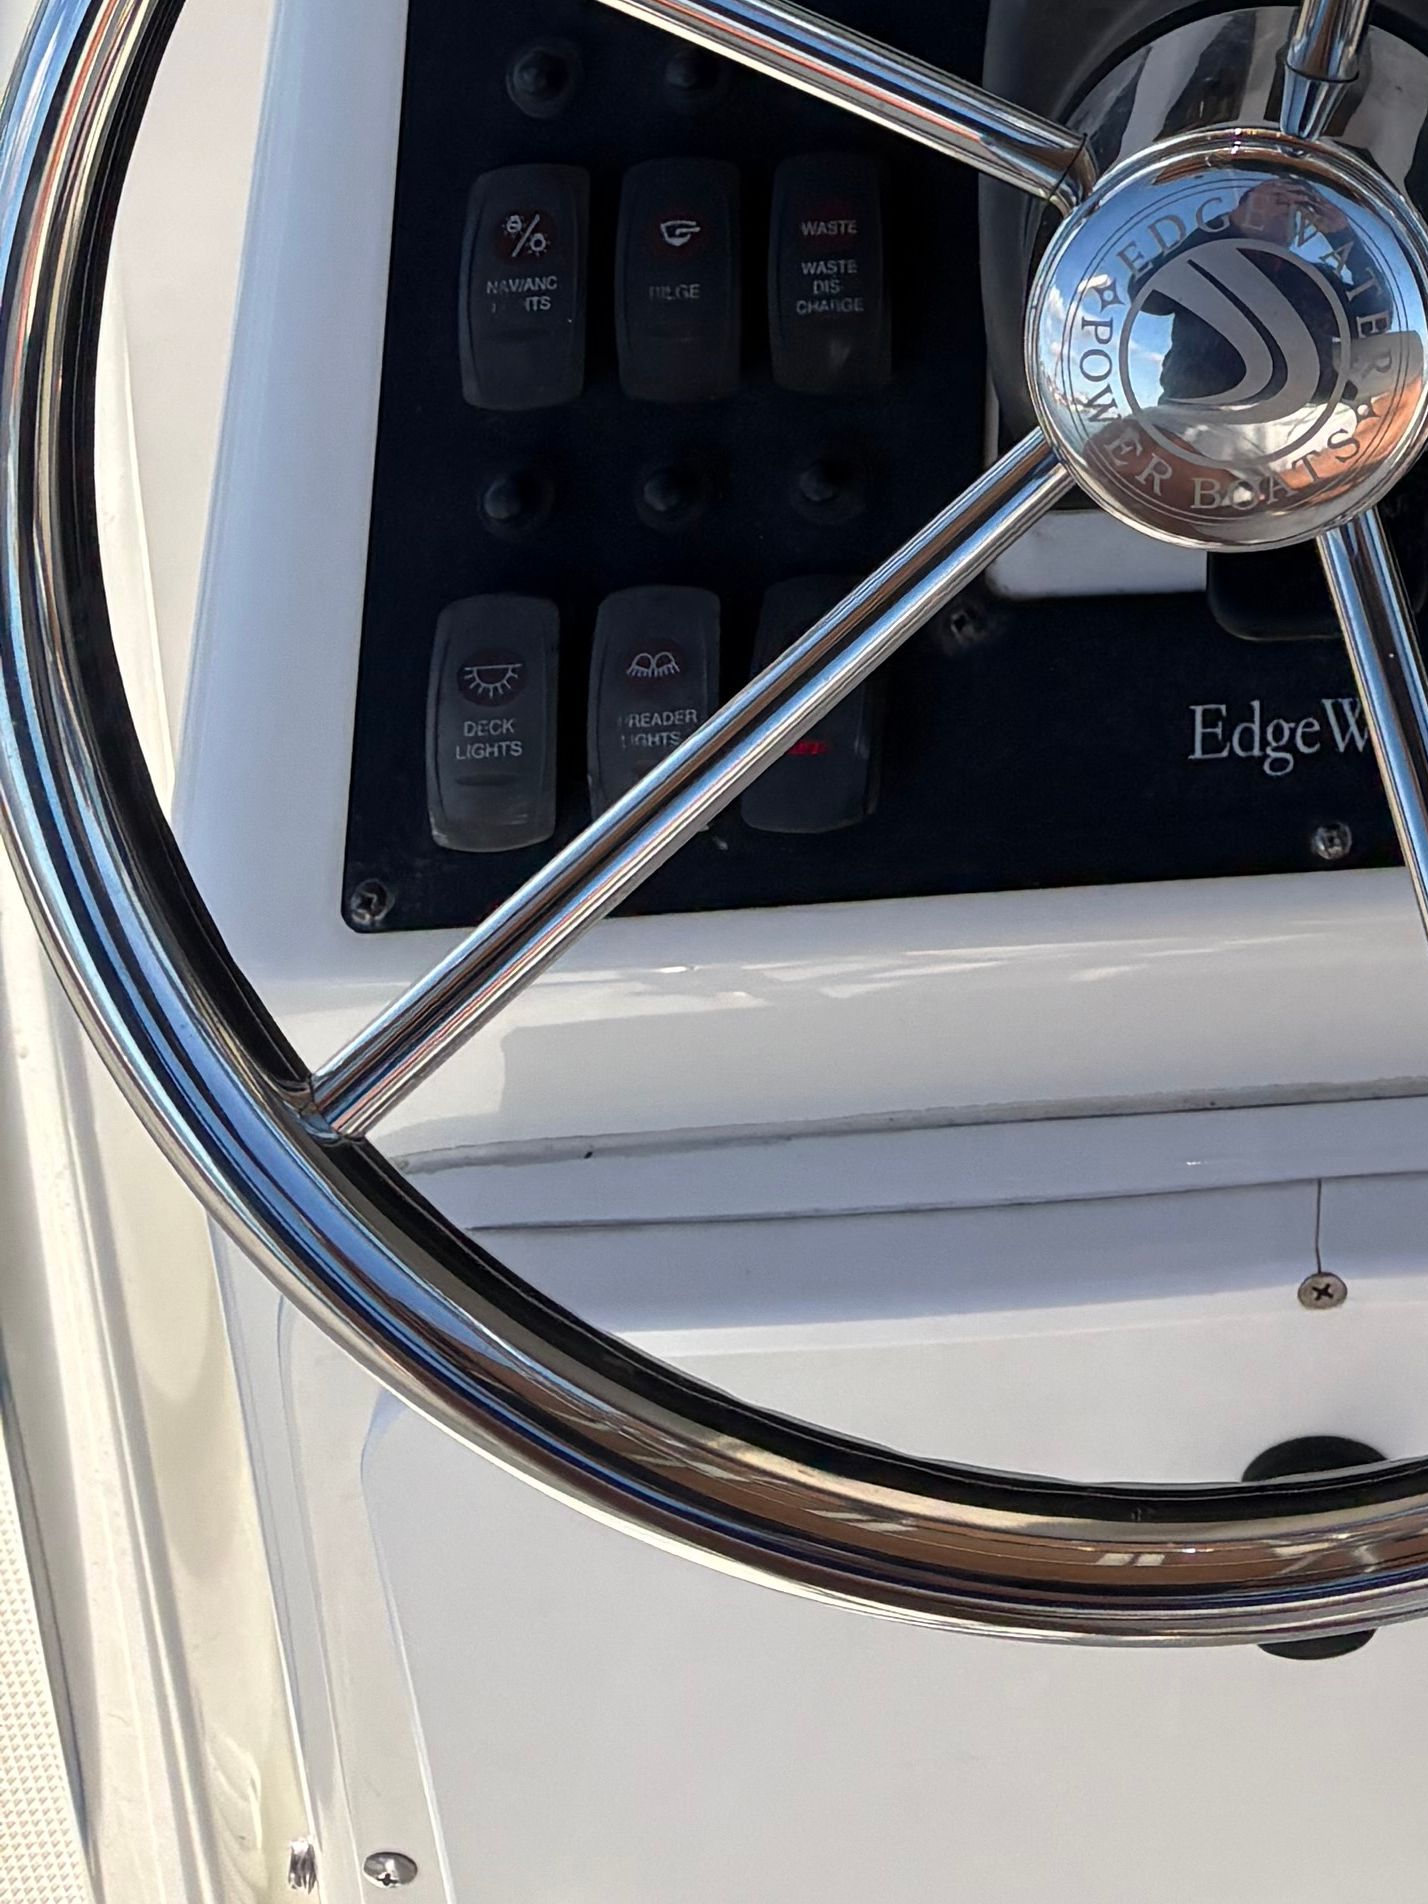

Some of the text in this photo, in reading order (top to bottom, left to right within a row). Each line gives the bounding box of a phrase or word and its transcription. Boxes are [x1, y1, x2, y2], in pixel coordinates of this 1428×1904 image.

[801, 220, 858, 236] WASTE
[801, 259, 858, 275] WASTE
[463, 719, 516, 736] DECK
[455, 741, 523, 760] LIGHTS
